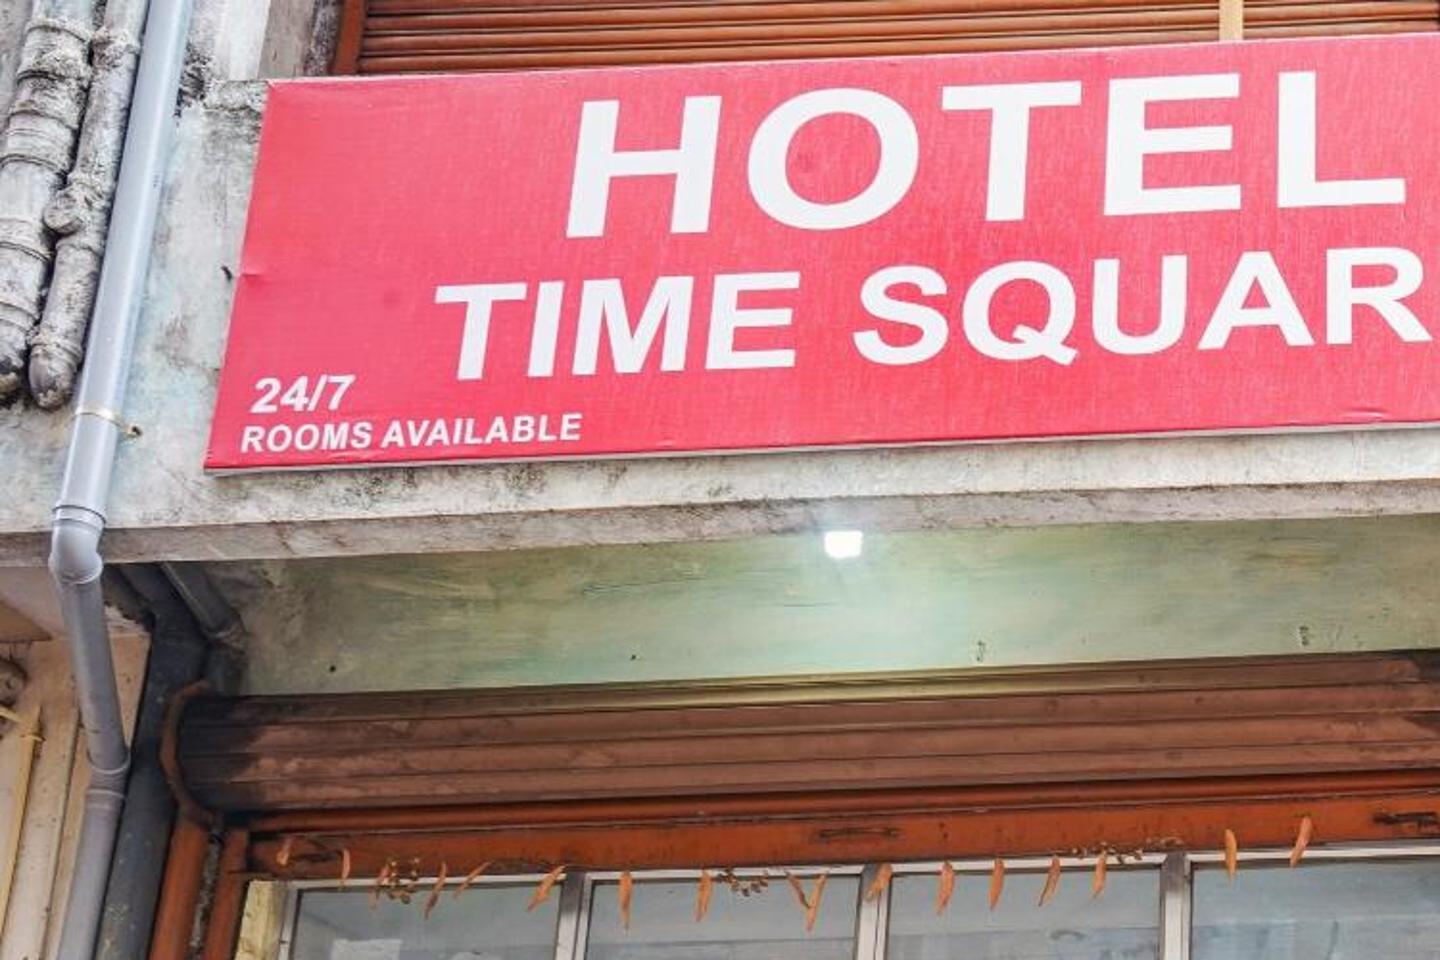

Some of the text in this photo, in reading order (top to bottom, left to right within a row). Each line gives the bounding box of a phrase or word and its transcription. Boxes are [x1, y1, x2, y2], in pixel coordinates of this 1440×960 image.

[566, 70, 1407, 238] HOTEL
[435, 272, 801, 380] TIME
[250, 374, 355, 413] 24/7
[241, 414, 582, 452] ROOMS AVAILABLE
